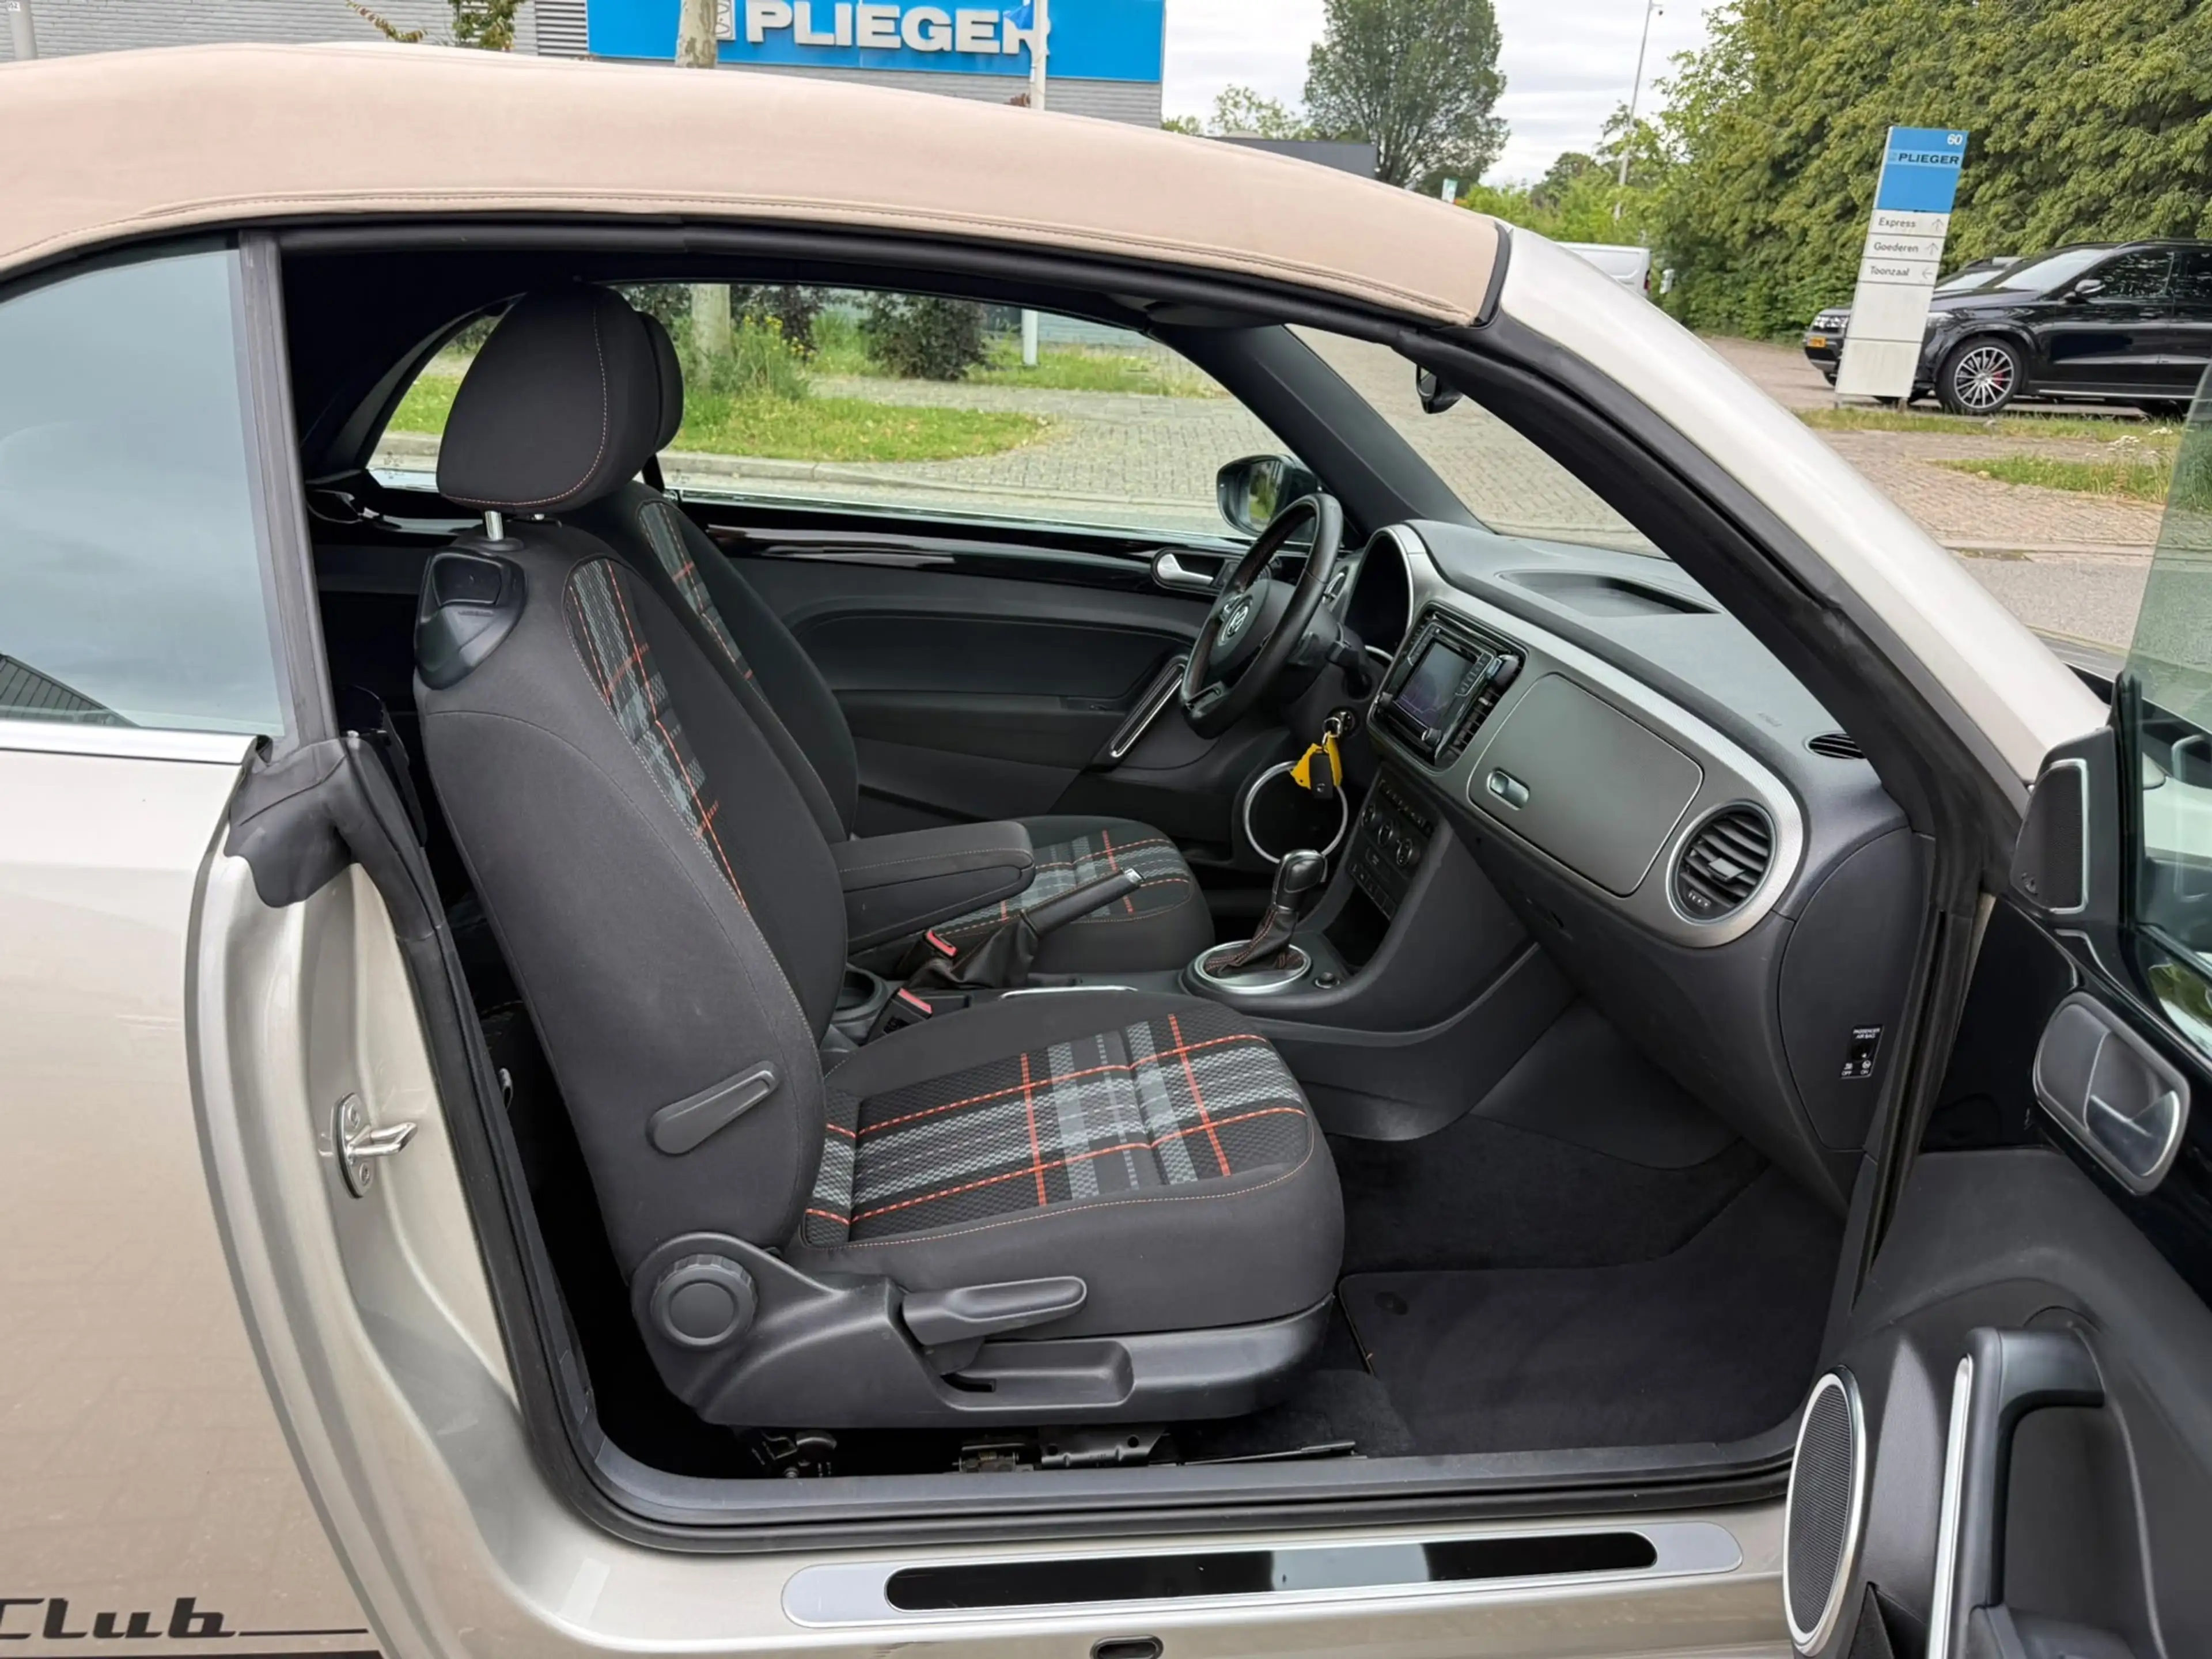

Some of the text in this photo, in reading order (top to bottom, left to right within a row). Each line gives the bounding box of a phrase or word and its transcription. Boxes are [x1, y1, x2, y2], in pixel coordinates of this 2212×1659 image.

[1947, 133, 1963, 145] 60
[1898, 152, 1960, 165] PLIEGER
[1878, 217, 1916, 228] Express
[1874, 242, 1919, 253] Goederen
[1870, 266, 1910, 276] Toonzaal
